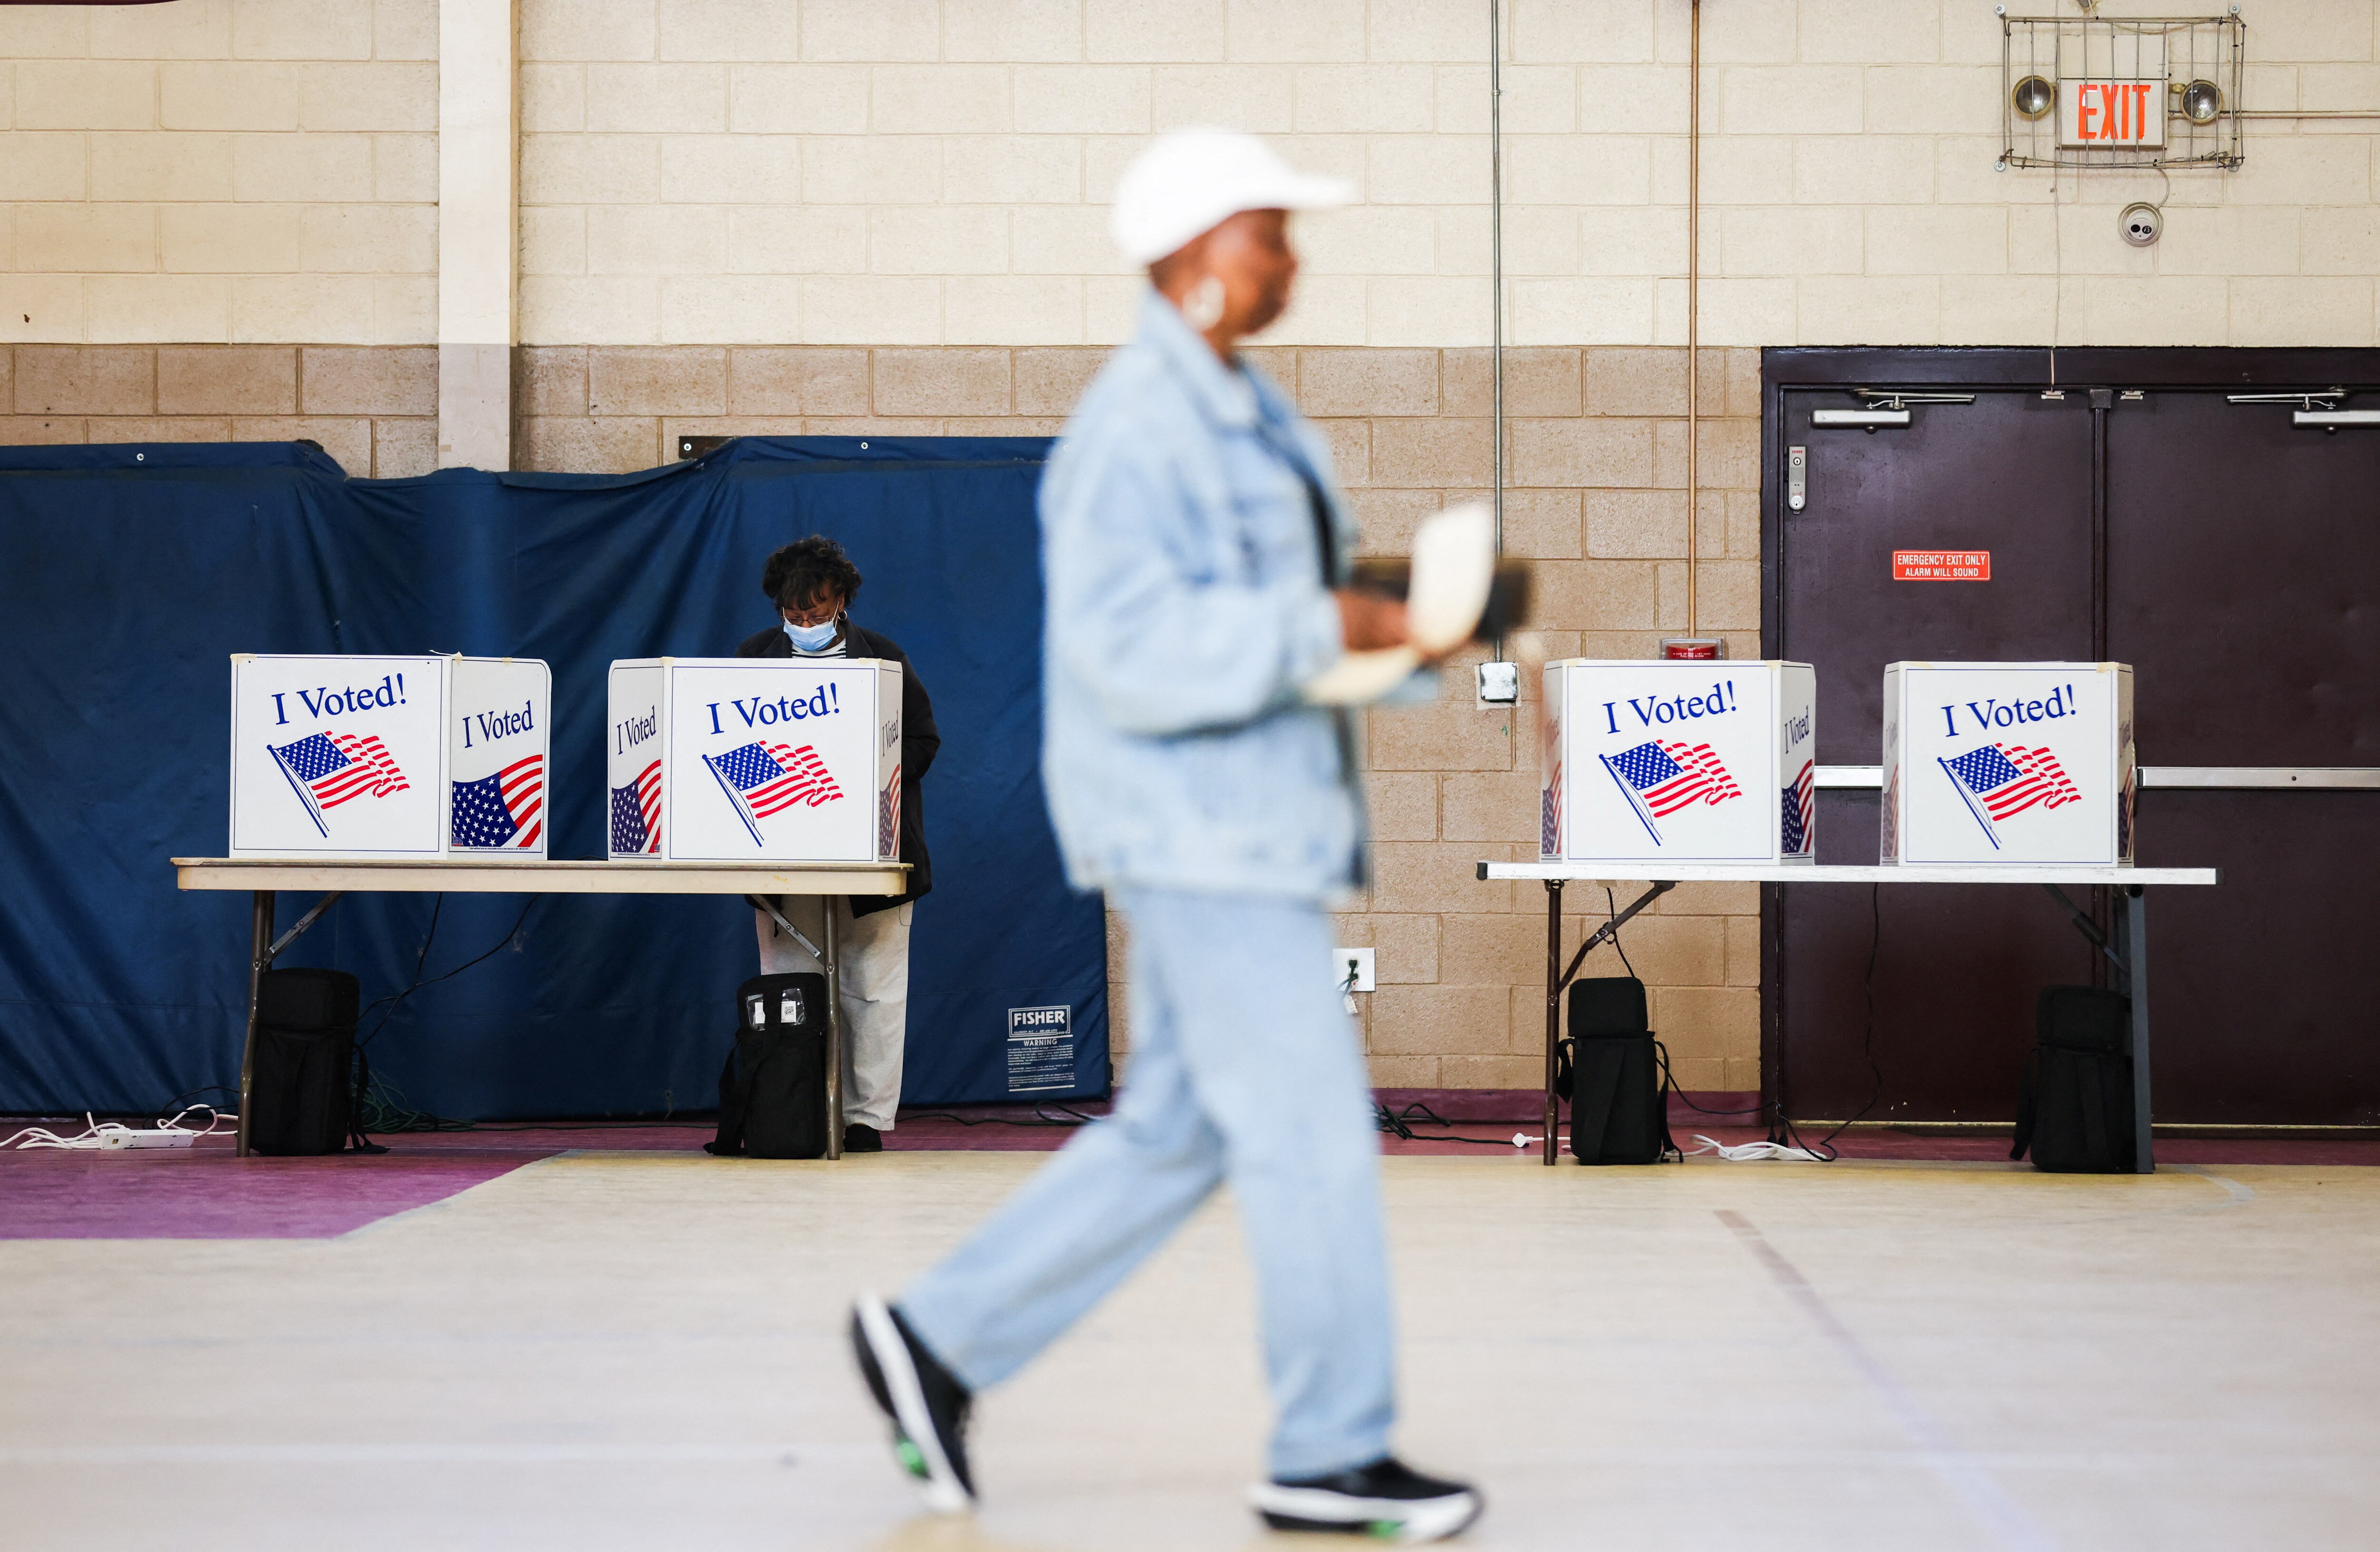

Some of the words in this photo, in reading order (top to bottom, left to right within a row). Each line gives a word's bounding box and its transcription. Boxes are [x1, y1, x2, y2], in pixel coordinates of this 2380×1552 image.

[2078, 84, 2151, 140] EXIT
[1897, 554, 1944, 565] EMERGENCY
[1946, 555, 1963, 565] EXIT
[1965, 555, 1986, 565] ONLY
[1905, 567, 1931, 577] ALARM
[1933, 567, 1951, 577] WILL
[1953, 567, 1979, 577] SOUND
[271, 693, 289, 725] I
[297, 673, 406, 719] Voted!
[462, 716, 473, 748] I
[476, 699, 534, 742] Voted
[706, 703, 724, 735] I
[731, 682, 840, 728] Voted!
[1603, 702, 1621, 734] I
[1627, 680, 1736, 727] Voted!
[1941, 706, 1960, 737] I
[1966, 684, 2076, 730] Voted!
[616, 724, 623, 756] I
[625, 705, 656, 748] Voted
[885, 709, 899, 751] Voted
[1789, 705, 1809, 746] Voted
[1014, 1010, 1065, 1026] FISHER
[1023, 1038, 1057, 1046] WARNING
